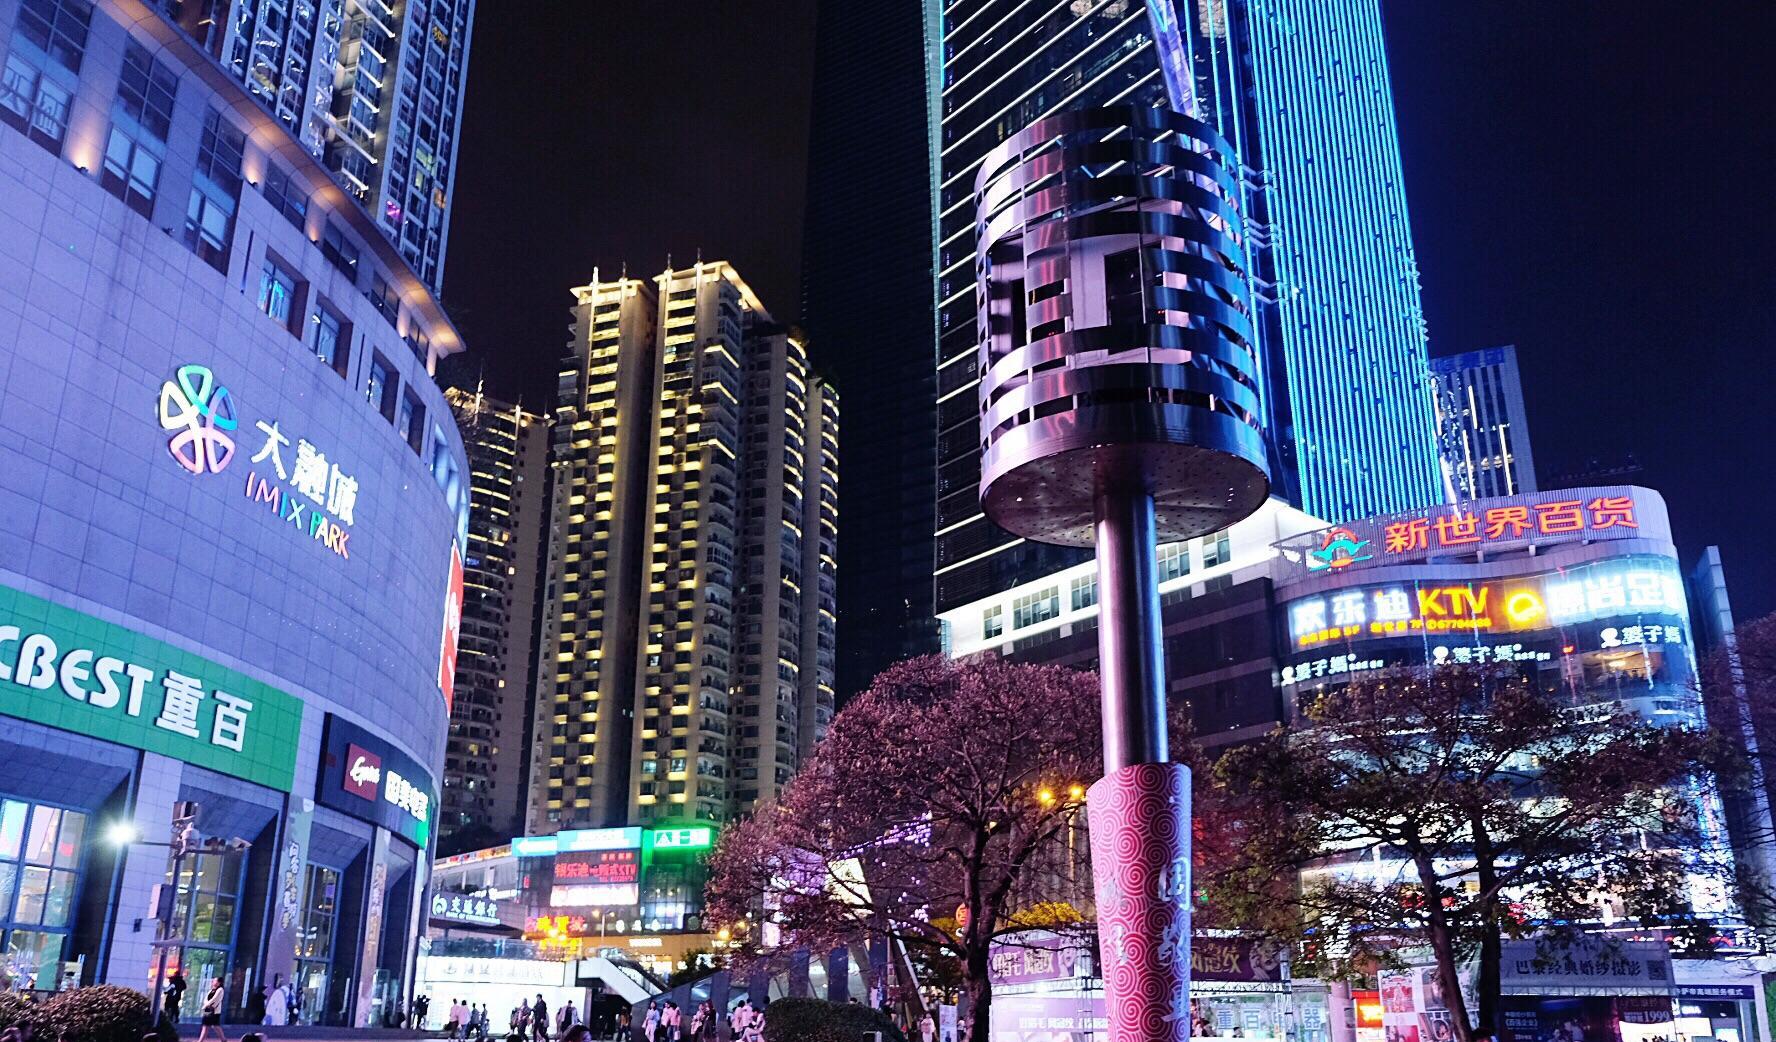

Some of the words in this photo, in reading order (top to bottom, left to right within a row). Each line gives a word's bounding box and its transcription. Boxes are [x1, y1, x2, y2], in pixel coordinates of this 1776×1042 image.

[251, 420, 359, 526] 大融城
[246, 472, 305, 529] IMIX
[309, 511, 349, 559] PARK
[1384, 496, 1639, 553] 新世界百货
[156, 670, 253, 752] 重百
[451, 896, 497, 918] 交通银行
[1644, 1011, 1670, 1023] 1999
